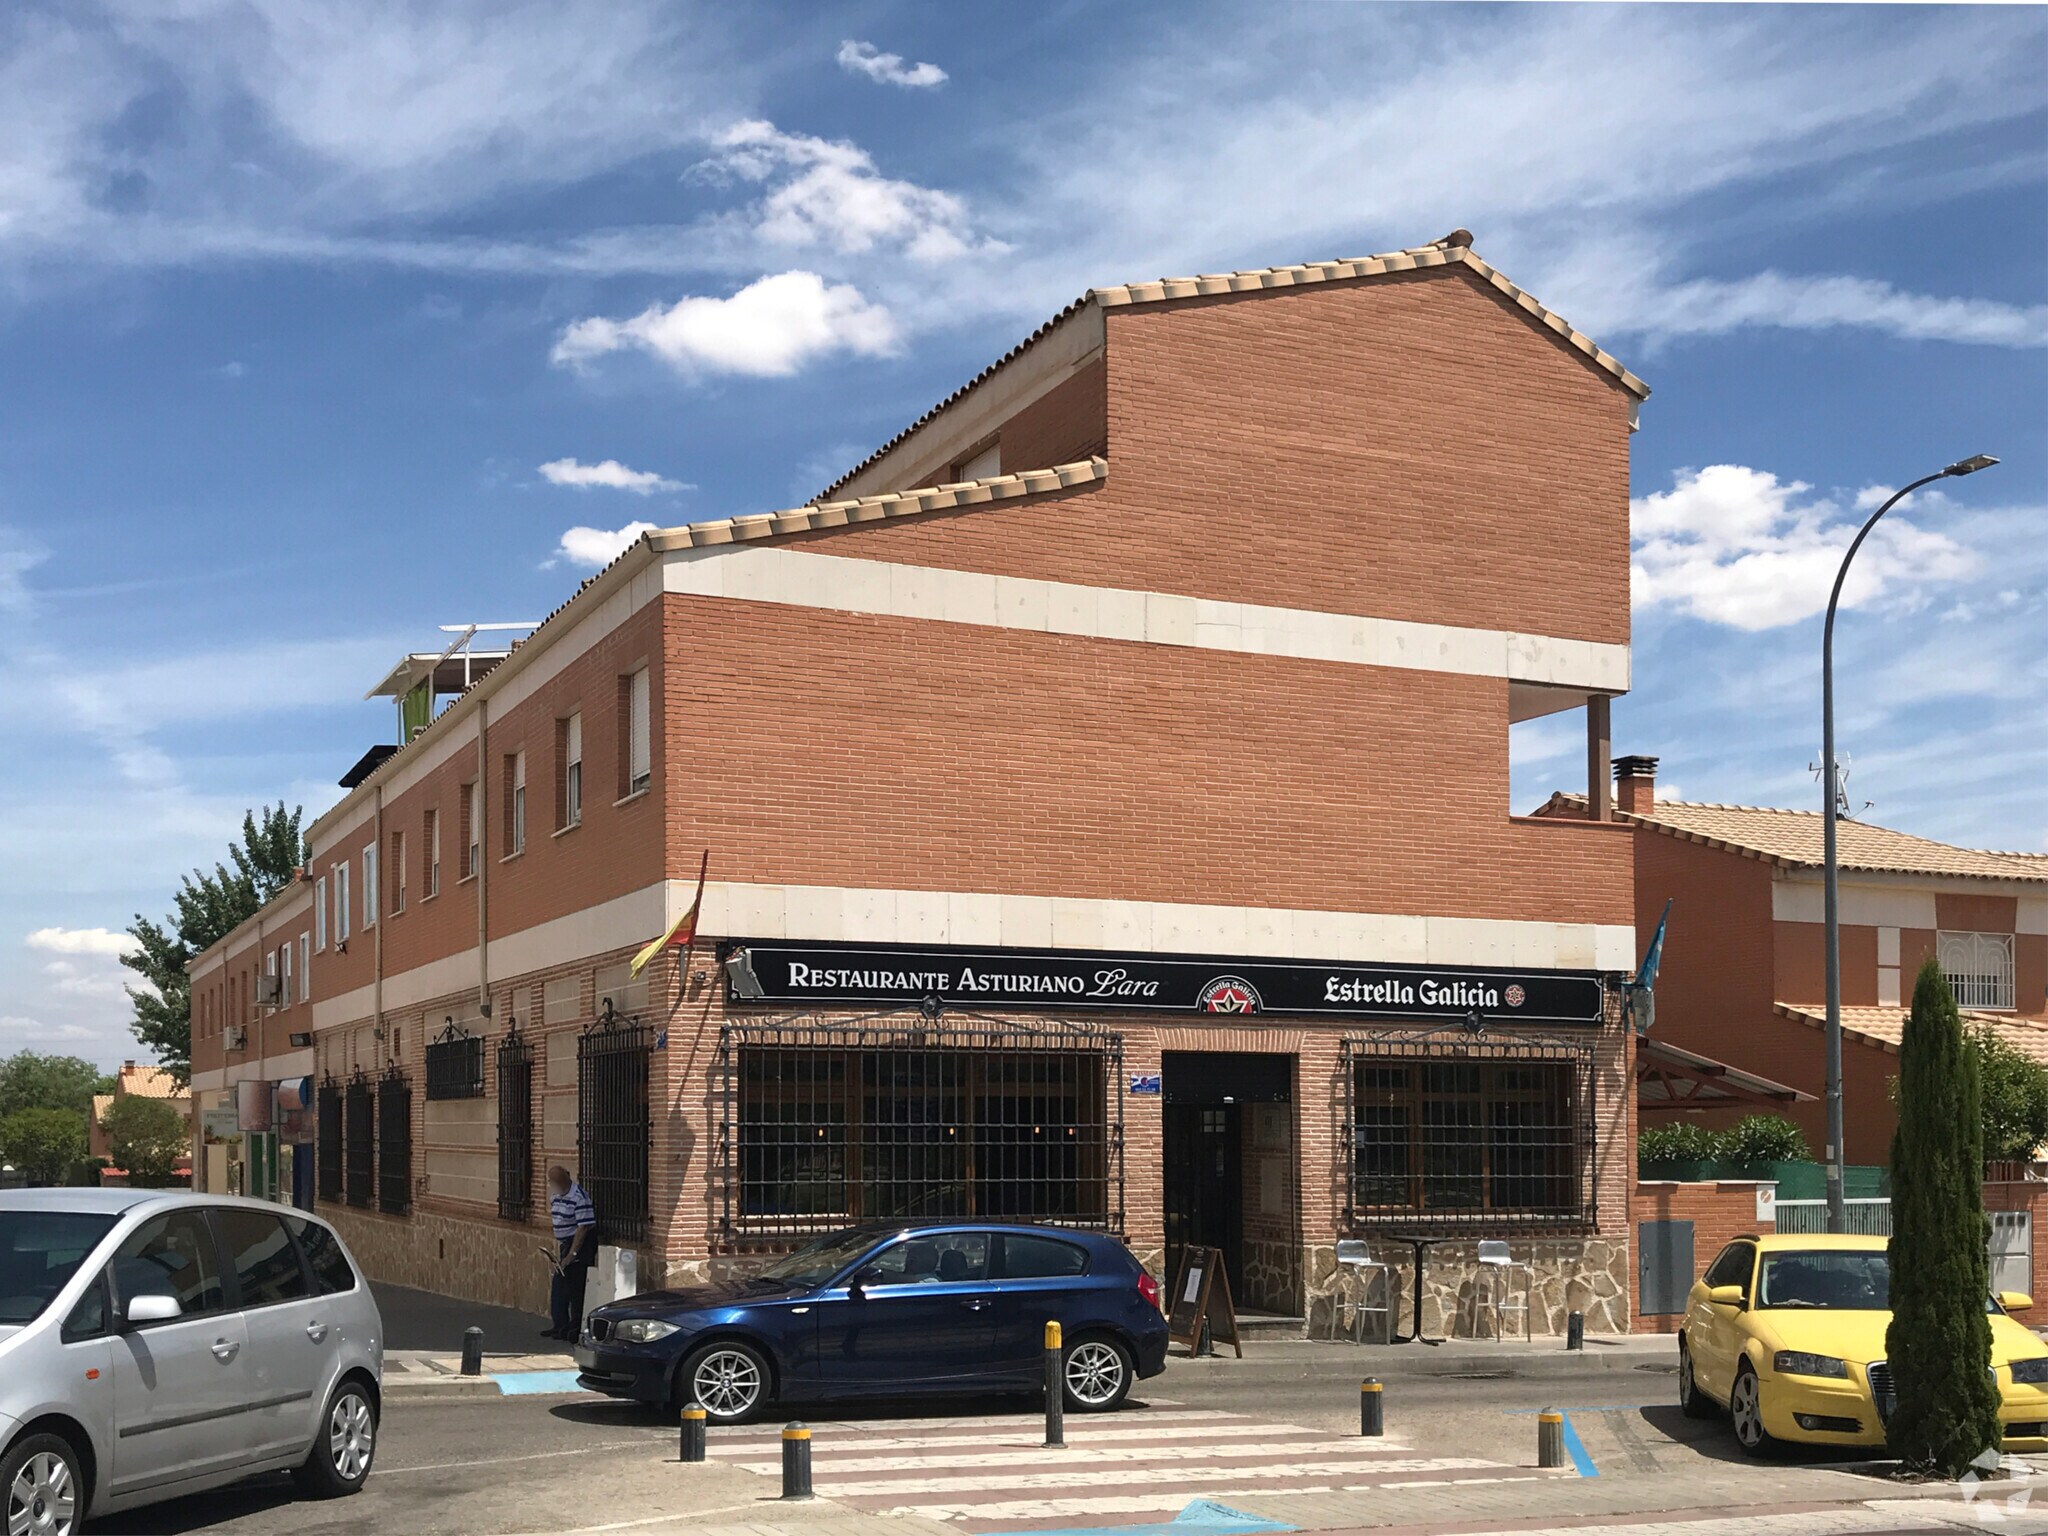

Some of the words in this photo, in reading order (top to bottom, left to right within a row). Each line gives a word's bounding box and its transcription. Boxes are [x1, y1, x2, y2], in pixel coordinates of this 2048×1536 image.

[788, 962, 949, 991] RESTAURANTE
[956, 967, 1085, 994] ASTURIANO
[1085, 968, 1160, 997] Lara
[1202, 981, 1231, 1004] Estrella
[1231, 981, 1256, 1006] Galicia
[1323, 975, 1415, 1005] Estrella
[1419, 979, 1500, 1008] Galicia
